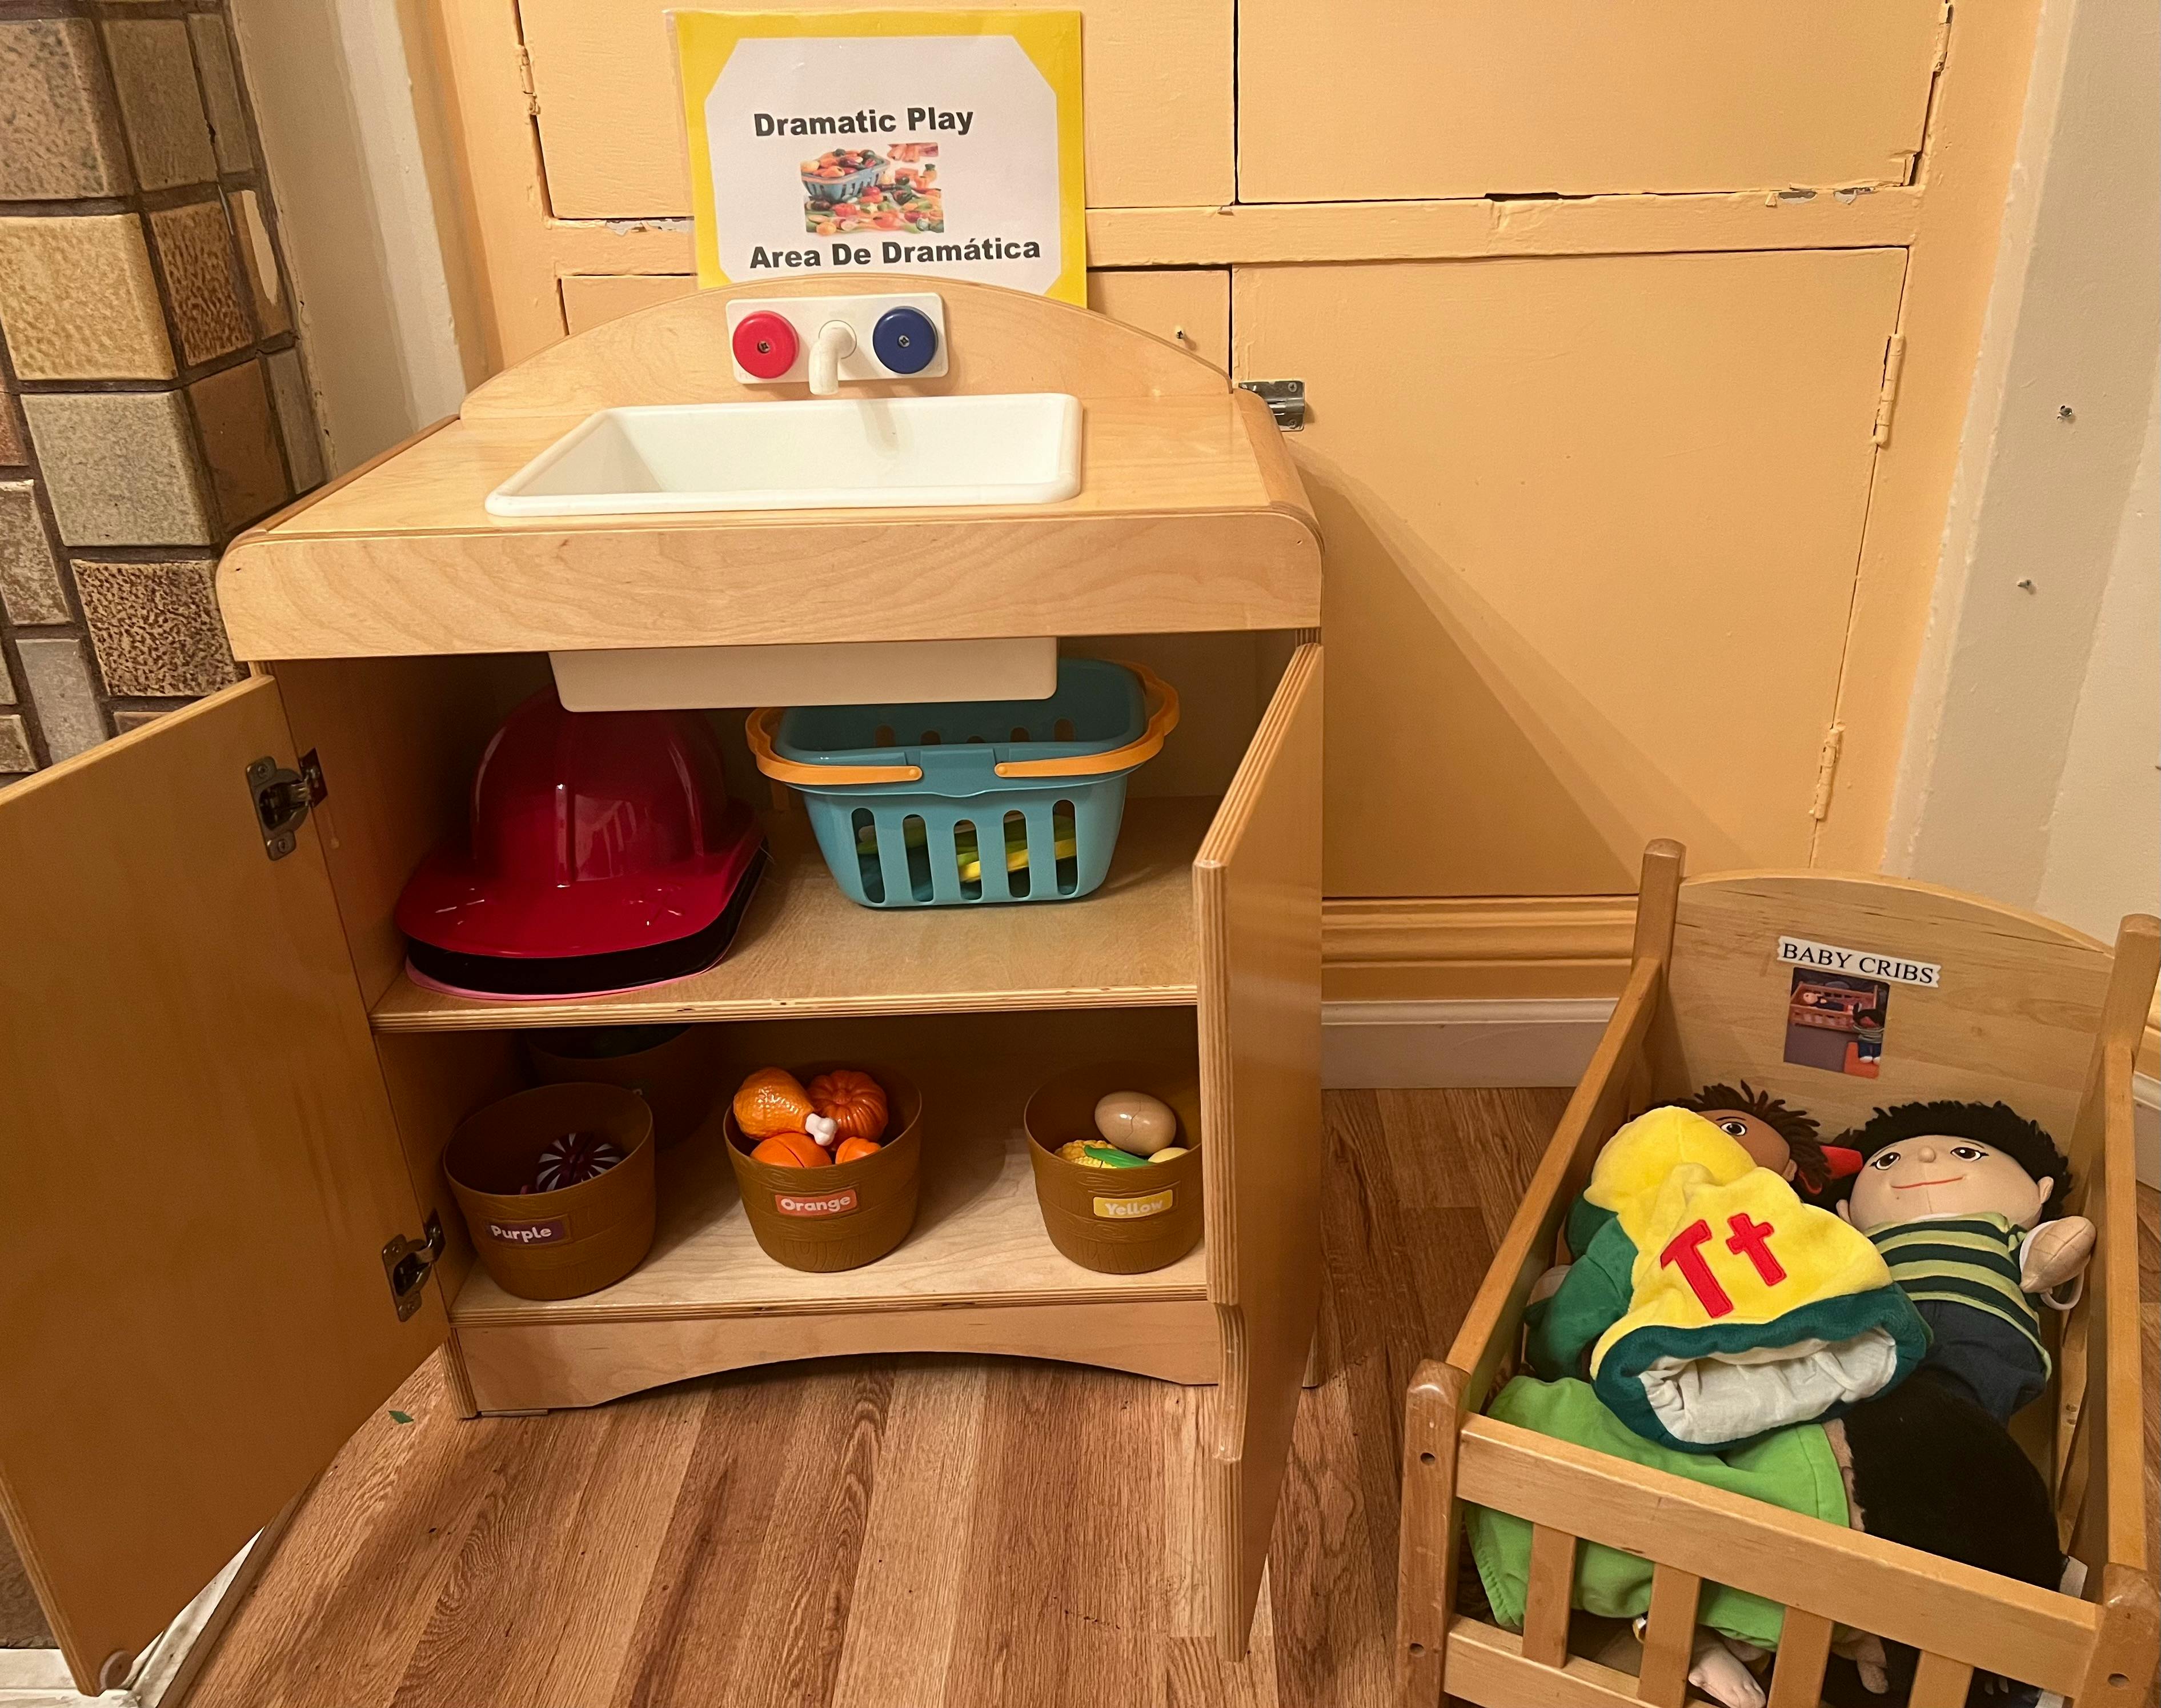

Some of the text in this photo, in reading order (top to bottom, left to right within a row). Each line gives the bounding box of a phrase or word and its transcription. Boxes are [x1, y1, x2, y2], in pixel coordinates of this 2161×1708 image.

[753, 107, 974, 137] Dramatic Play
[749, 236, 1041, 269] Area De Dramática
[1782, 943, 1934, 984] BABY CRIBS
[780, 1196, 851, 1212] Orange
[1104, 1200, 1164, 1216] Yellow
[490, 1225, 552, 1244] Purple
